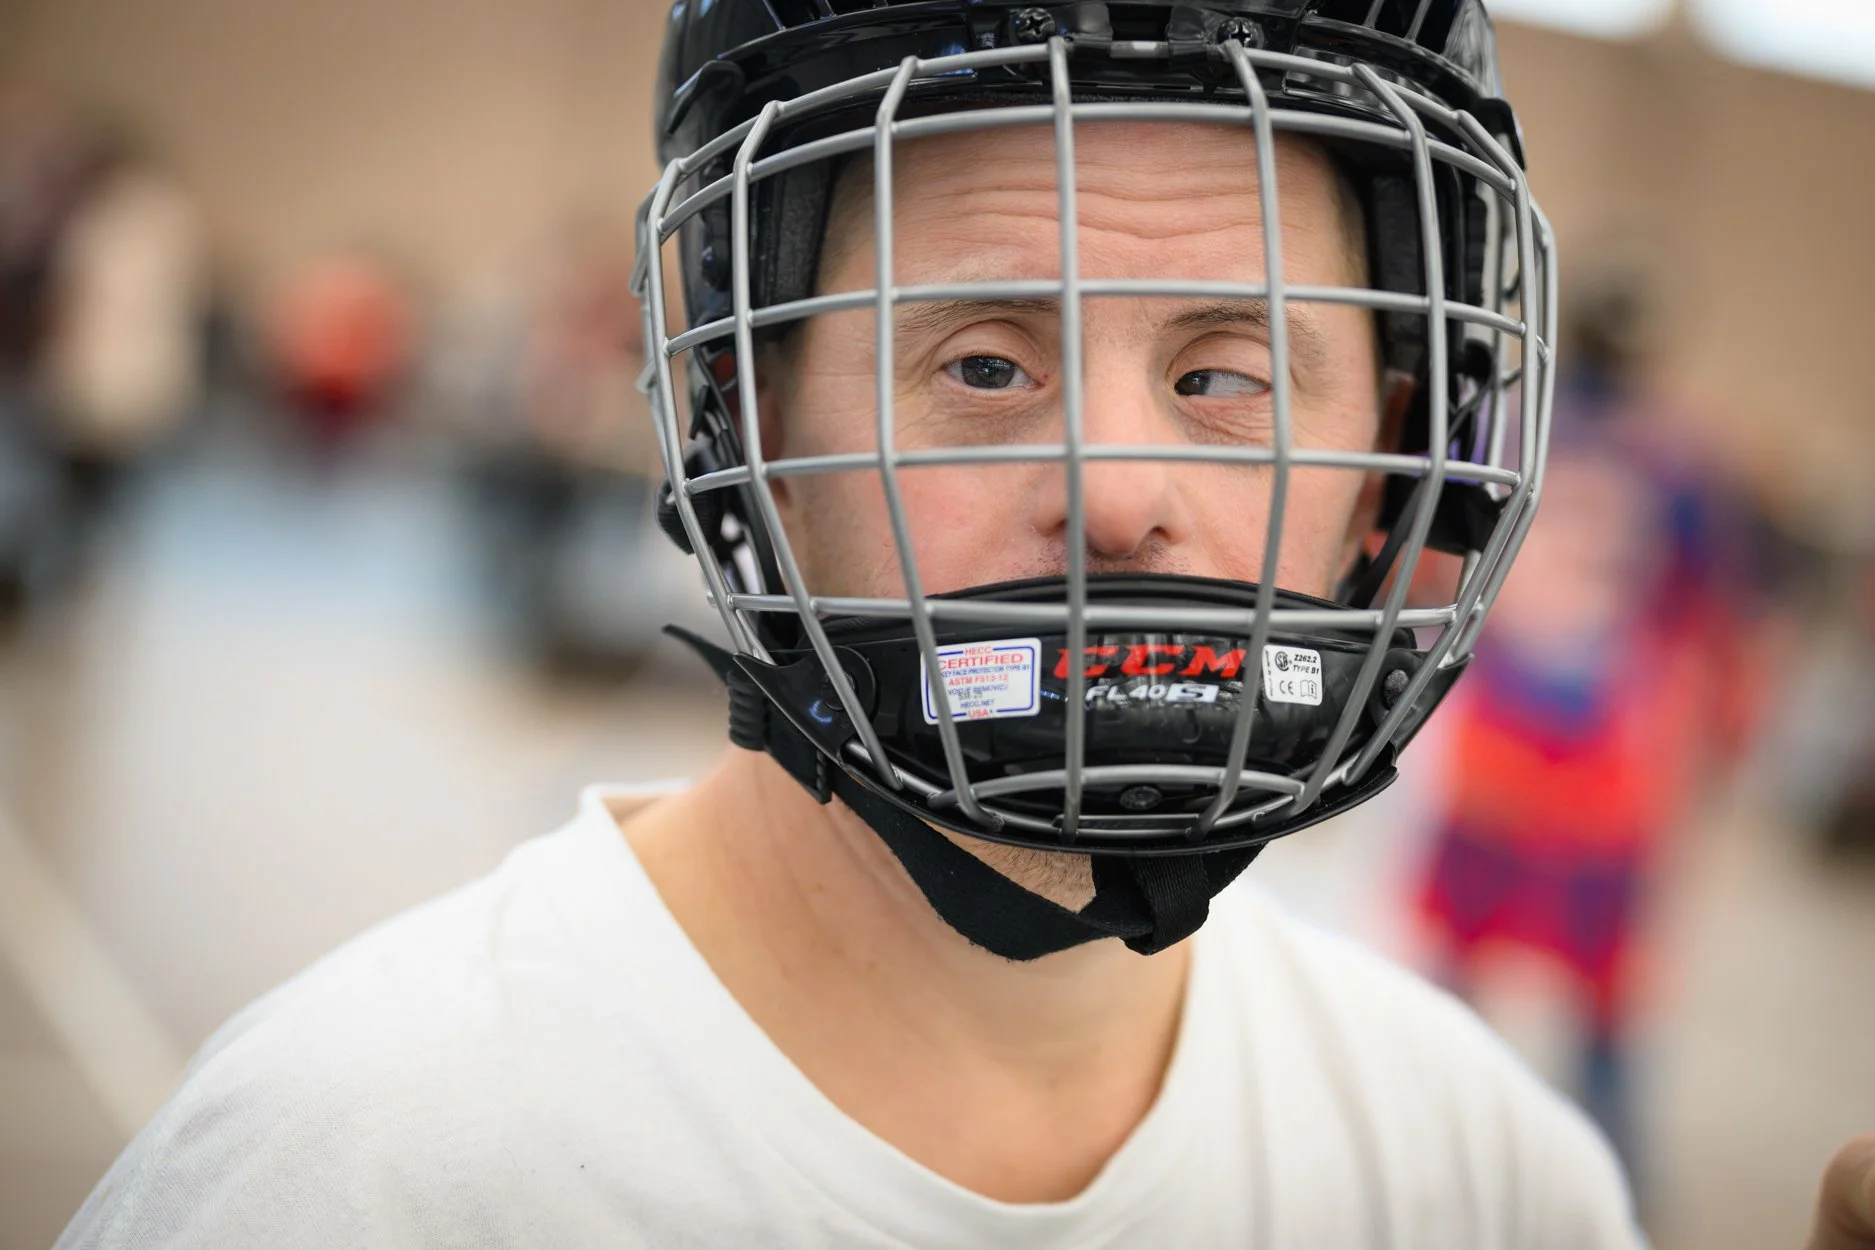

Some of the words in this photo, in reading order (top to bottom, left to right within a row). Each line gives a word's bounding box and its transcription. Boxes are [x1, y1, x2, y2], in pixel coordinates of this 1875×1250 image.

[965, 646, 992, 656] HECC
[938, 654, 1024, 671] CERTIFIED
[1053, 644, 1247, 679] CCM
[1294, 653, 1317, 664] Z262.2
[1293, 664, 1310, 674] TYPE
[1311, 666, 1320, 675] B1
[948, 676, 973, 686] ASTM
[1085, 684, 1168, 701] FL40
[1279, 680, 1294, 695] CE
[968, 708, 989, 718] USA
